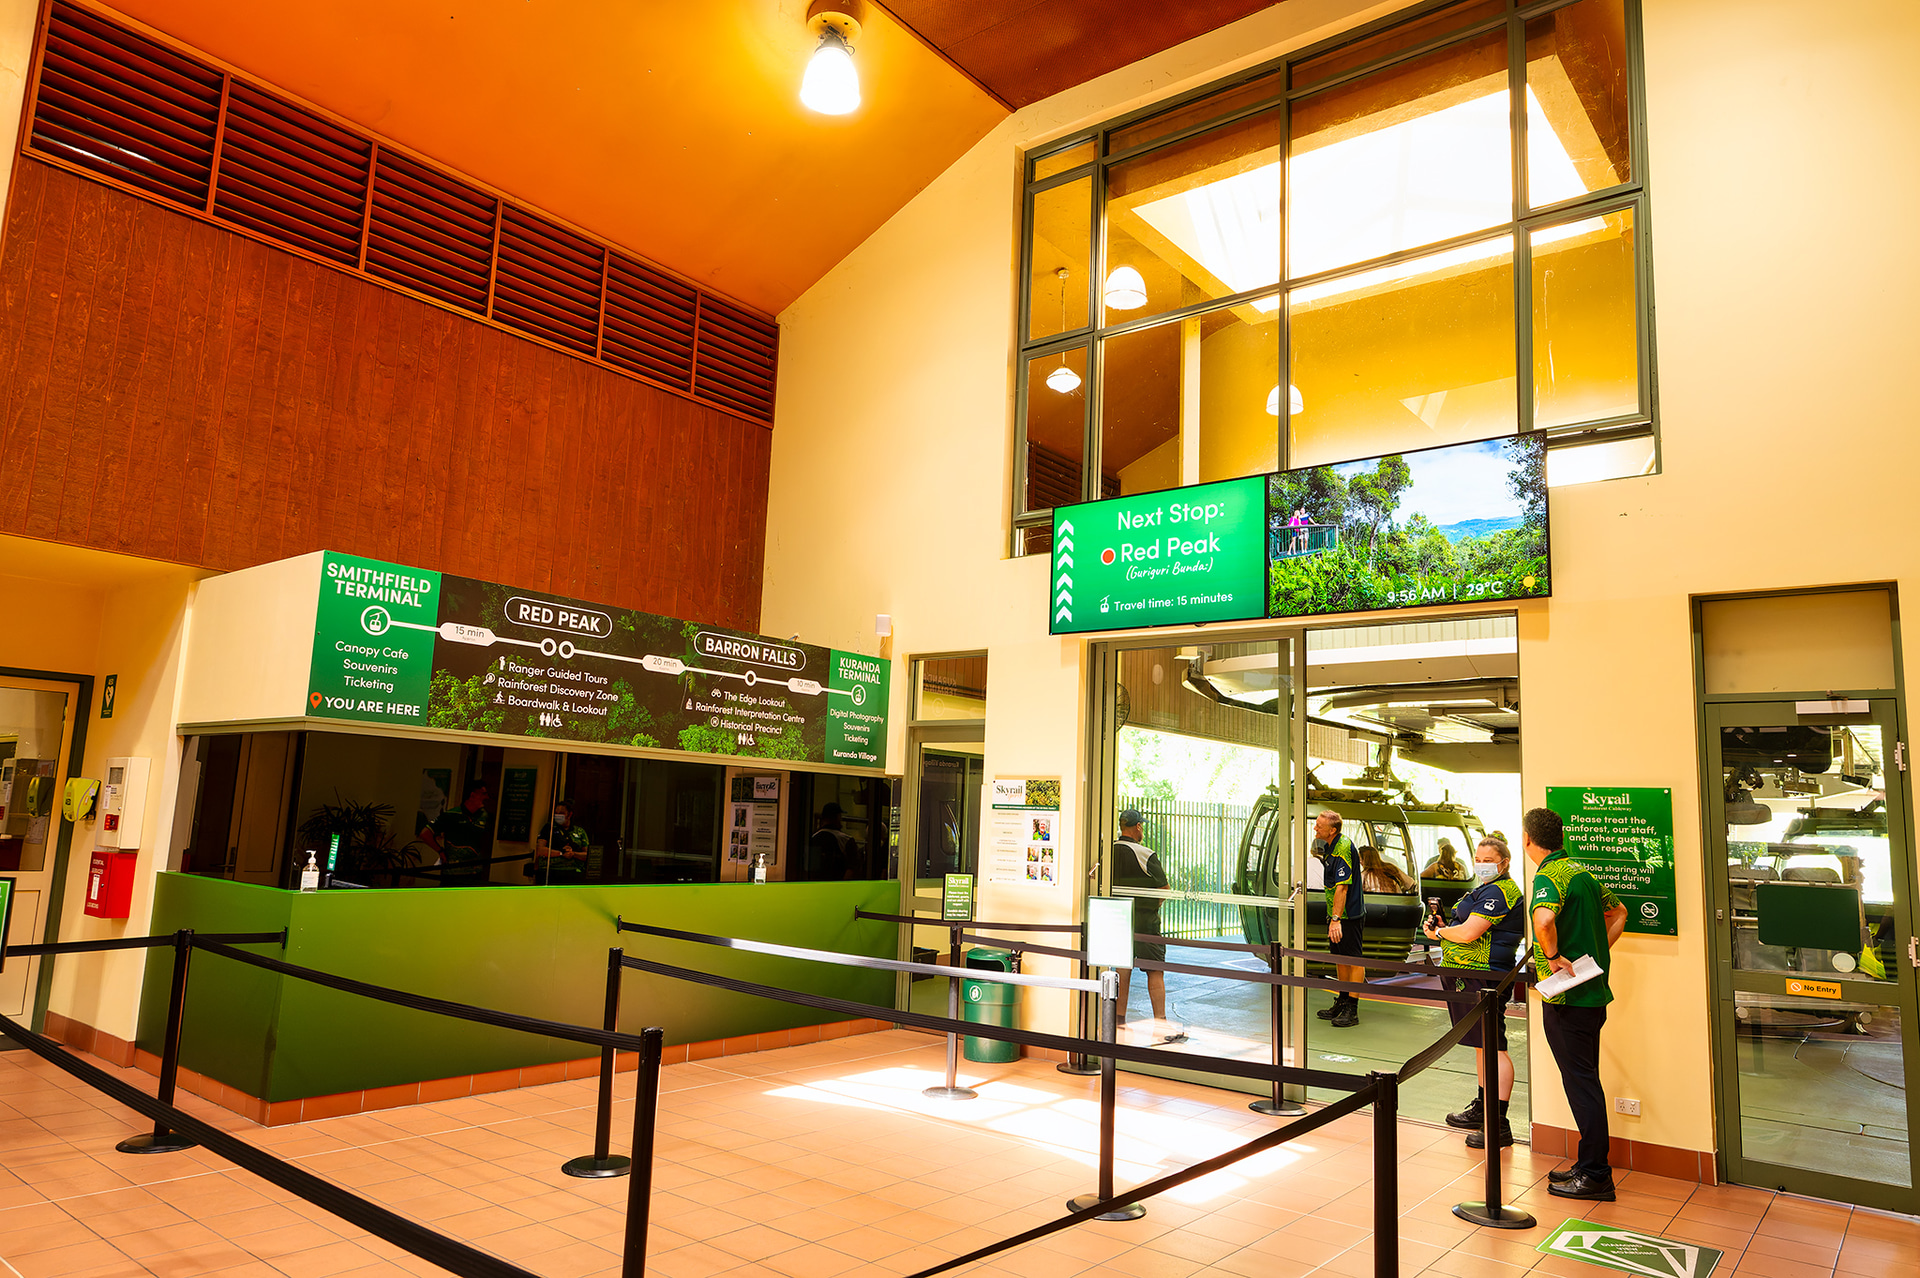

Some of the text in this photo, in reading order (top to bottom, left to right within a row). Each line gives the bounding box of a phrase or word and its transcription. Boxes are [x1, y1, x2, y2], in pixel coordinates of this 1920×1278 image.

[1117, 502, 1225, 530] Next Stop:
[1121, 532, 1221, 562] Red Peak
[326, 562, 431, 593] SMITHFIELD
[1126, 564, 1170, 581] (Guriguri
[334, 579, 422, 608] TERMINAL
[1386, 587, 1446, 603] 9:56 AM
[1466, 581, 1504, 597] 29°C
[1114, 592, 1233, 612] Travel time: 15 minutes
[518, 603, 601, 633] RED PEAK
[455, 625, 485, 638] 15 min
[335, 640, 409, 660] Canopy Cafe
[705, 638, 797, 666] BARRON FALLS
[343, 658, 398, 676] Souvenirs
[652, 657, 677, 668] 20 min
[839, 656, 881, 675] KURANDA
[508, 661, 608, 685] Ranger Guided Tours
[838, 668, 881, 685] TERMINAL
[343, 675, 394, 694] Ticketing
[498, 677, 619, 702] Rainforest Discovery Zone
[804, 681, 816, 689] min
[325, 696, 421, 717] YOU ARE HERE
[508, 694, 608, 716] Boardwalk & Lookout
[724, 691, 786, 708] The Edge Lookout
[695, 702, 805, 725] Rainforest Interpretation Centre
[830, 708, 885, 725] Digital Photography
[720, 719, 782, 735] Historical Precinct
[843, 722, 870, 733] Souvenirs
[843, 733, 869, 746] Ticketing
[833, 749, 877, 762] Kuranda Village
[996, 784, 1023, 796] Skyrail
[1582, 792, 1630, 807] Skyrail
[1570, 814, 1647, 825] Please treat the
[1562, 823, 1657, 835] rainforest, our staff,
[1569, 834, 1588, 842] and
[1590, 834, 1616, 843] other
[1578, 844, 1599, 852] with
[1604, 864, 1638, 875] sharing
[1639, 865, 1655, 875] will
[1622, 873, 1651, 885] during
[1803, 984, 1837, 995] No Entry
